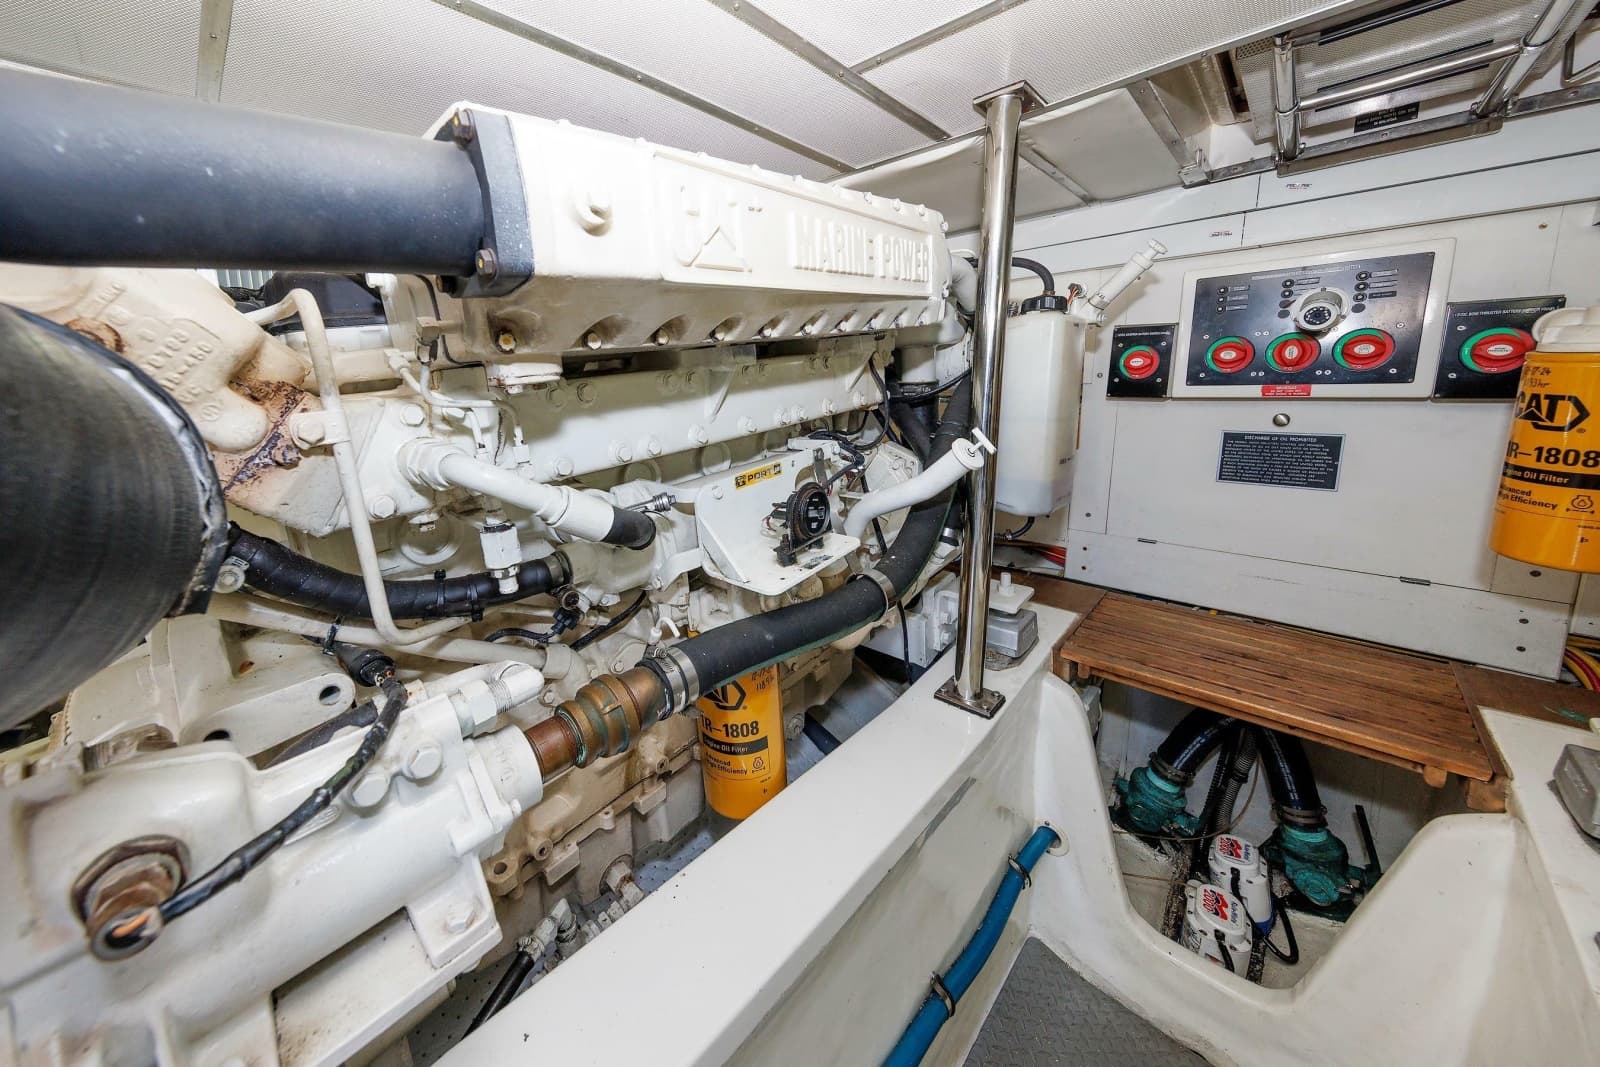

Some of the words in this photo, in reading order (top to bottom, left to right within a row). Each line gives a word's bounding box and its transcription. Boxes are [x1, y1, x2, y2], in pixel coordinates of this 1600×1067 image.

[875, 232, 930, 283] POWER
[1514, 392, 1567, 424] CAT
[748, 468, 773, 482] PORT
[1523, 470, 1537, 480] Oil
[1539, 473, 1570, 485] Filter
[1510, 492, 1559, 511] Efficiency
[731, 745, 748, 753] Filter
[1203, 889, 1216, 912] 2000
